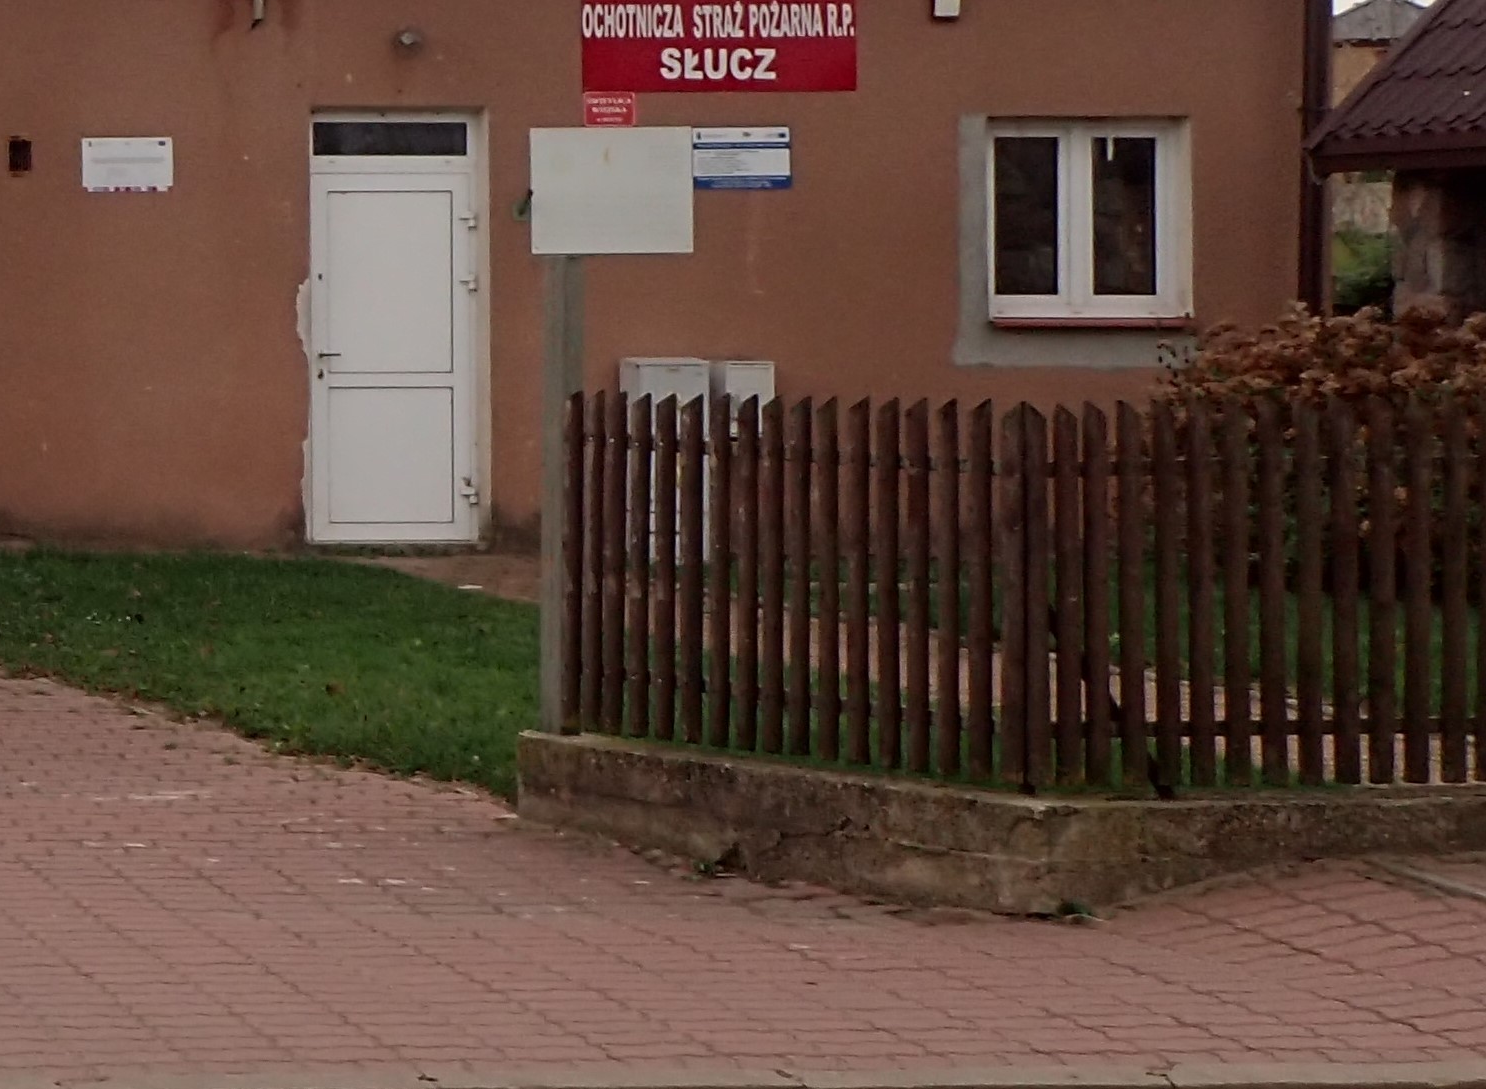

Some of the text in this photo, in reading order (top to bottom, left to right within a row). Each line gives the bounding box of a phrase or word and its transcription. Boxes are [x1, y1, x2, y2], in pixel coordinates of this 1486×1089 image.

[582, 0, 854, 38] OCHOTNICZA STRAŻ POŻARNA R.P.
[660, 47, 777, 80] SŁUCZ
